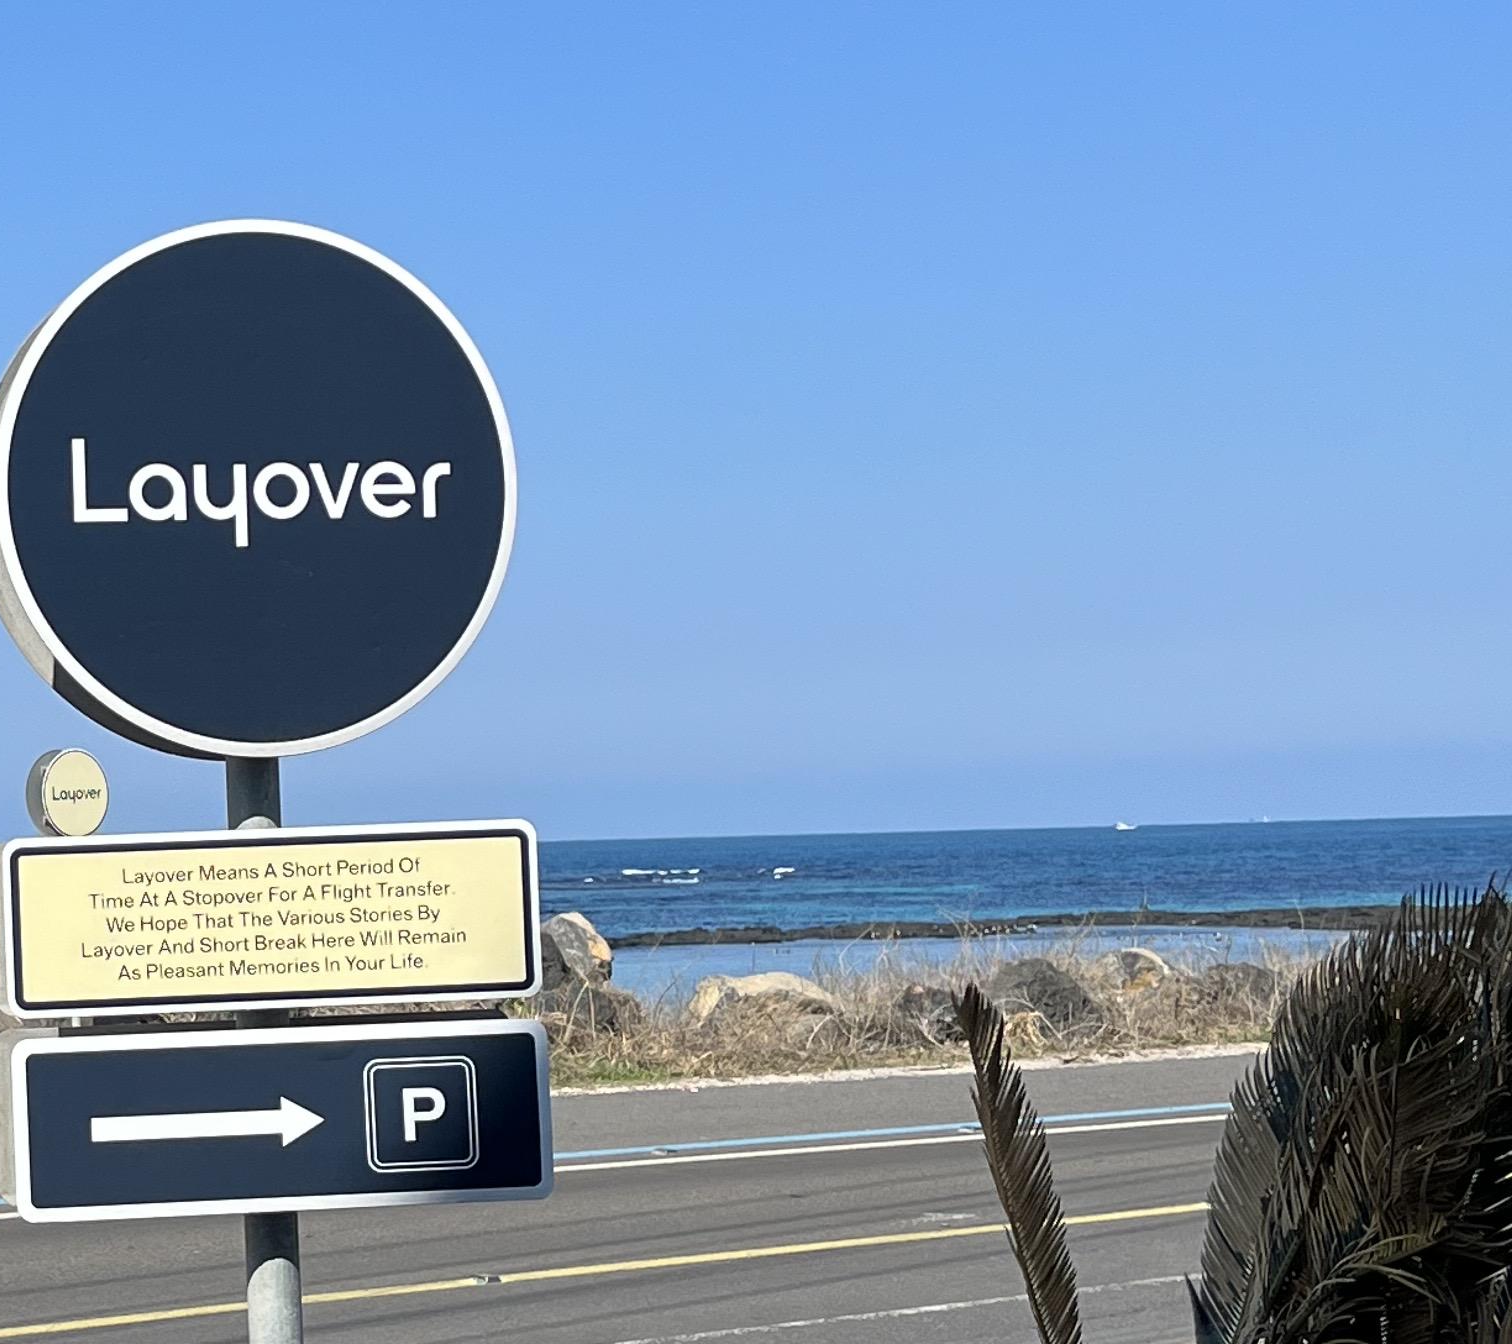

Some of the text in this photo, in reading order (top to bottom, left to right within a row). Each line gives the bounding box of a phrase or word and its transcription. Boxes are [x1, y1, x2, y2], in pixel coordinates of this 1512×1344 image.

[71, 437, 451, 548] Layover
[51, 785, 102, 805] Layover
[121, 856, 421, 887] Layover Means A Short Period Of
[87, 892, 135, 910] Time
[138, 891, 160, 909] At
[163, 889, 179, 907] A
[182, 889, 264, 908] Stopover
[268, 885, 298, 903] For
[302, 884, 317, 902] A
[320, 882, 372, 904] Flight
[105, 903, 441, 935] We Hope That The Various Stories By
[80, 927, 467, 961] Layover And Short Break Here Will Remain
[117, 964, 142, 981] As
[146, 961, 225, 980] Pleasant
[228, 957, 321, 977] Memories
[324, 955, 341, 973] In
[344, 954, 386, 972] Your
[402, 1087, 446, 1142] P
